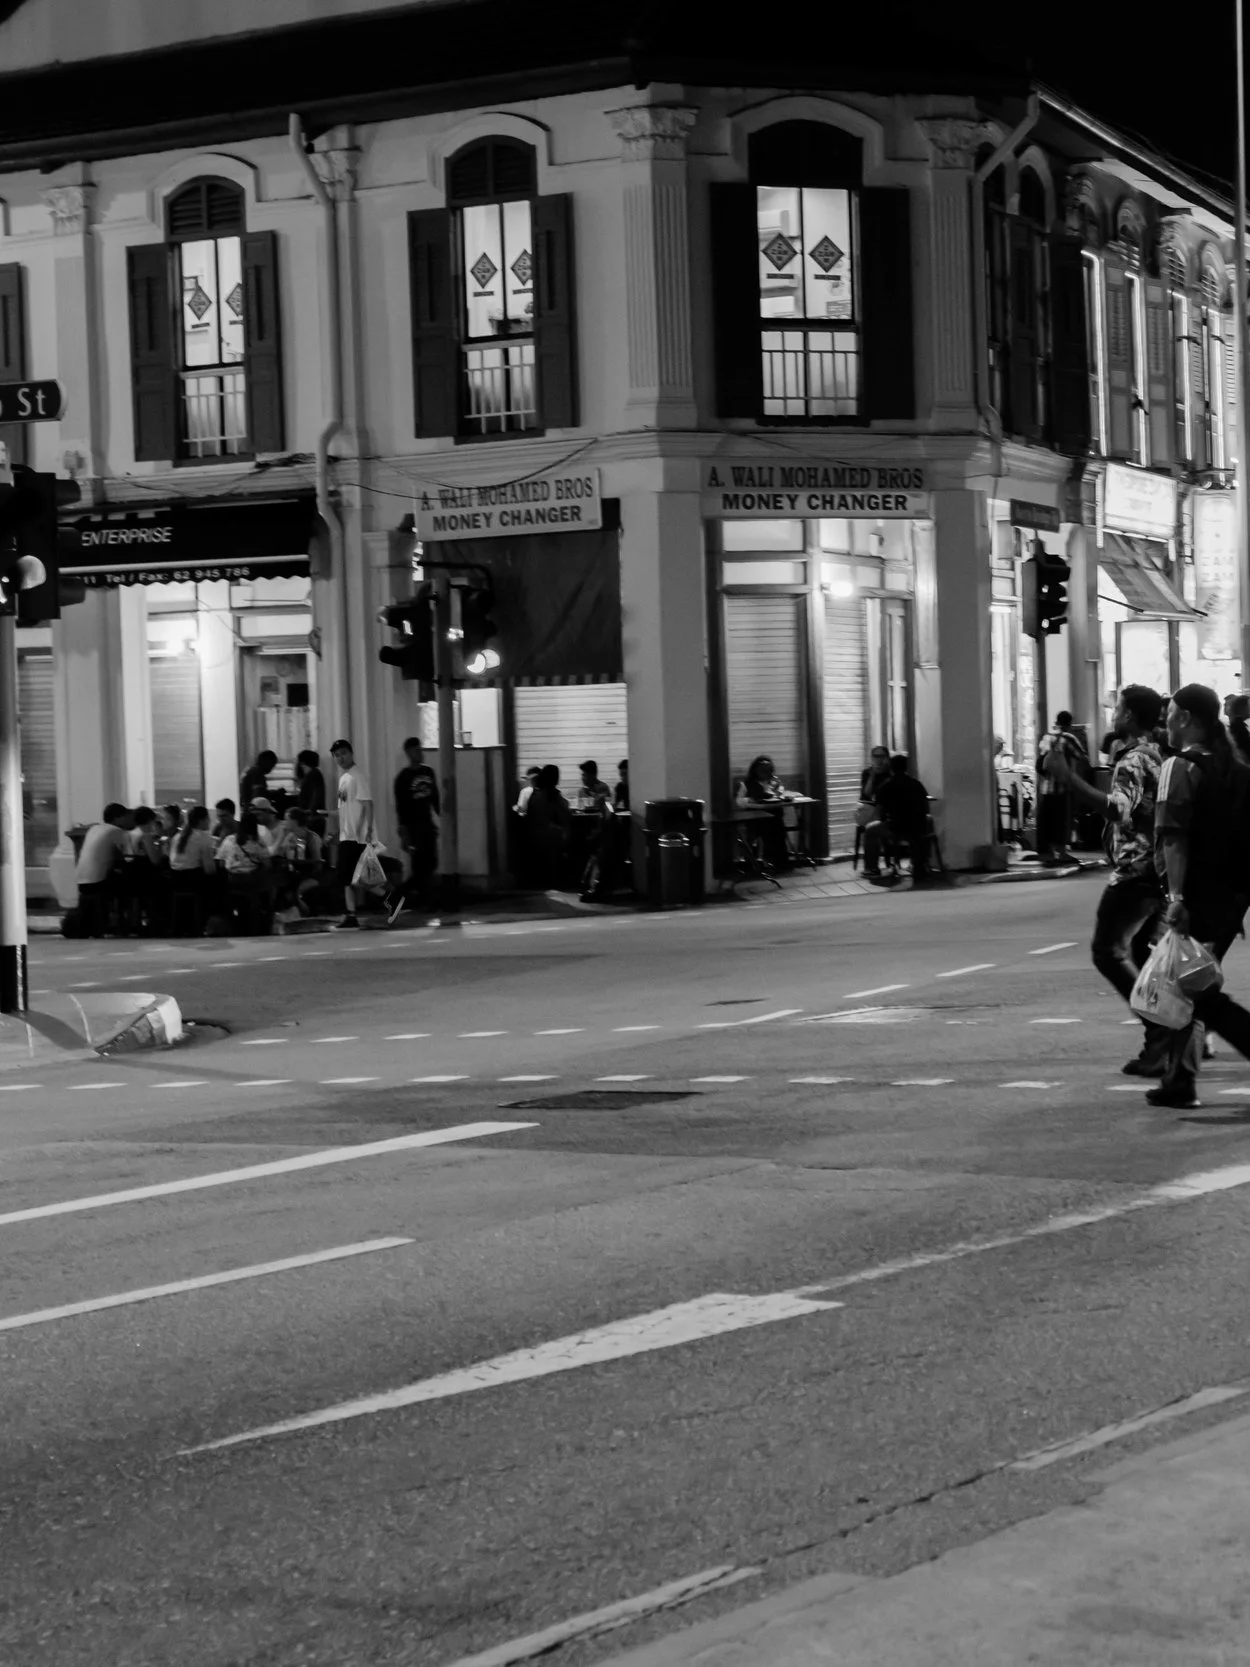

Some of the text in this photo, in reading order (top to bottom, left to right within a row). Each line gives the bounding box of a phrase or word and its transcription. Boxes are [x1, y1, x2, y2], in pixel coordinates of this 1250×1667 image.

[16, 387, 47, 417] St
[708, 466, 923, 489] A. WALI MOHAMED BROS
[438, 488, 473, 509] WALI
[478, 481, 550, 507] MOHAMED
[555, 477, 593, 501] BROS
[722, 494, 908, 511] MONEY CHANGER
[433, 505, 582, 532] MONEY CHANGER
[81, 526, 173, 546] ENTERPRISE
[105, 573, 126, 584] Tel
[172, 570, 191, 581] 62
